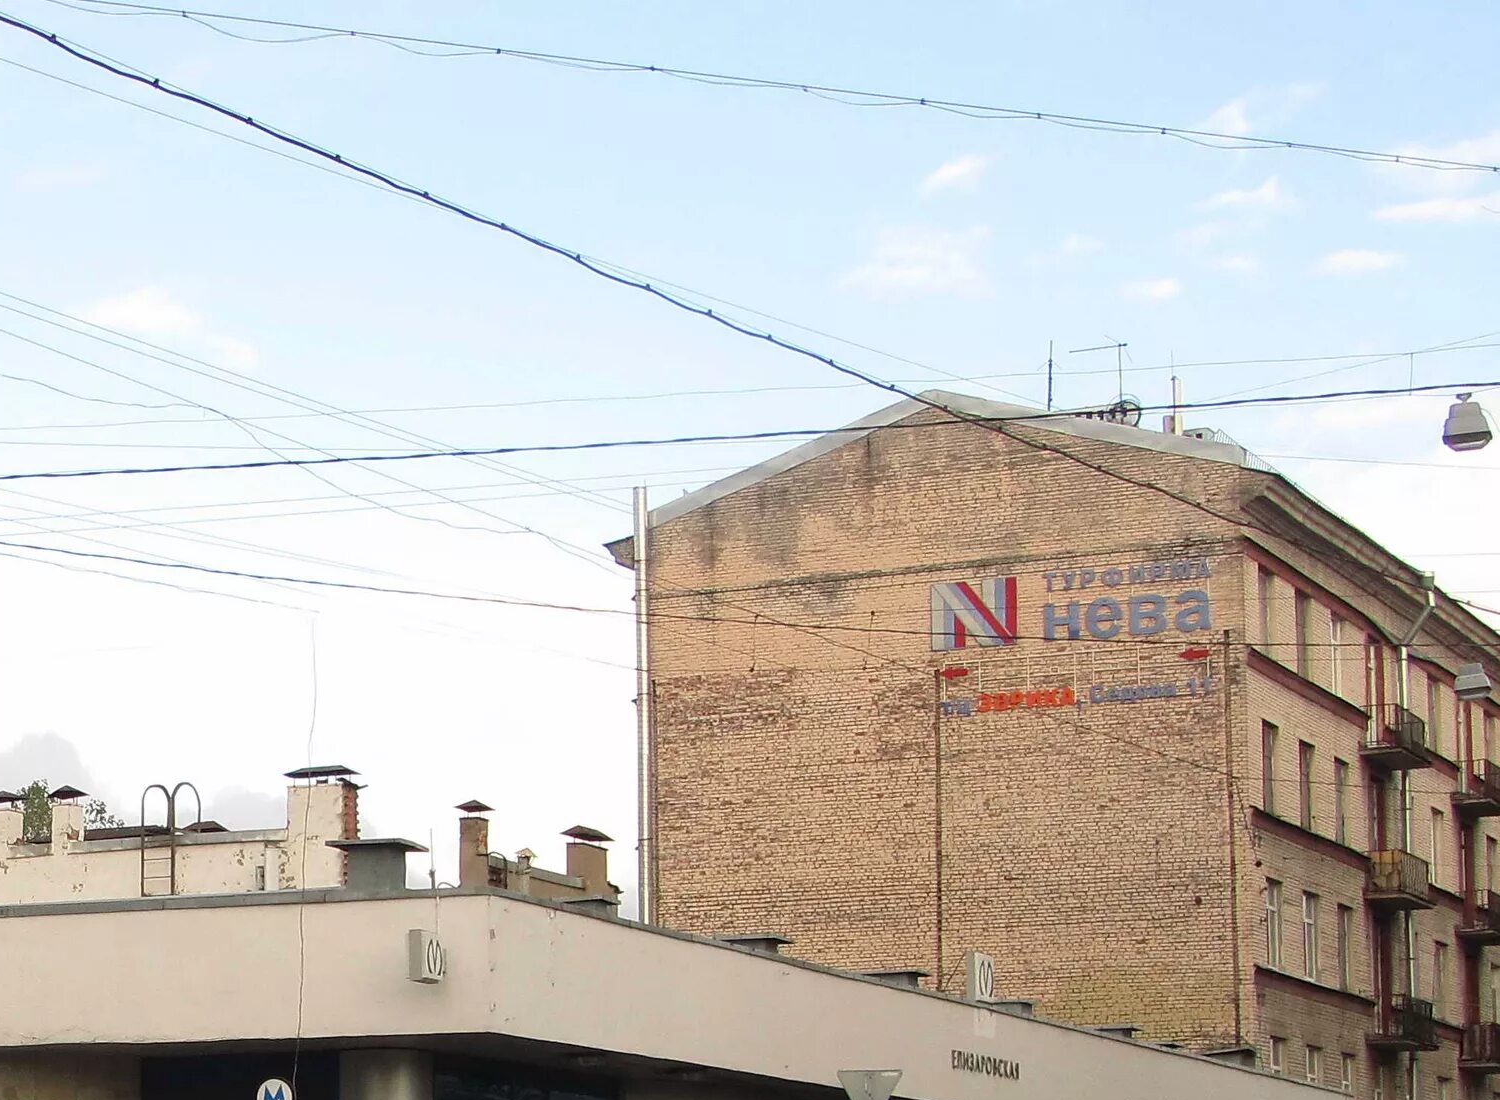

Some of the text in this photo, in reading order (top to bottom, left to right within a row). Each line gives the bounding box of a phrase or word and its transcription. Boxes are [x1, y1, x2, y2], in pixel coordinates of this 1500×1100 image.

[1043, 557, 1212, 593] ТУРФИРМА
[1043, 588, 1212, 640] нева
[950, 1048, 1020, 1081] ЕЛИЗАРОВСКАЯ
